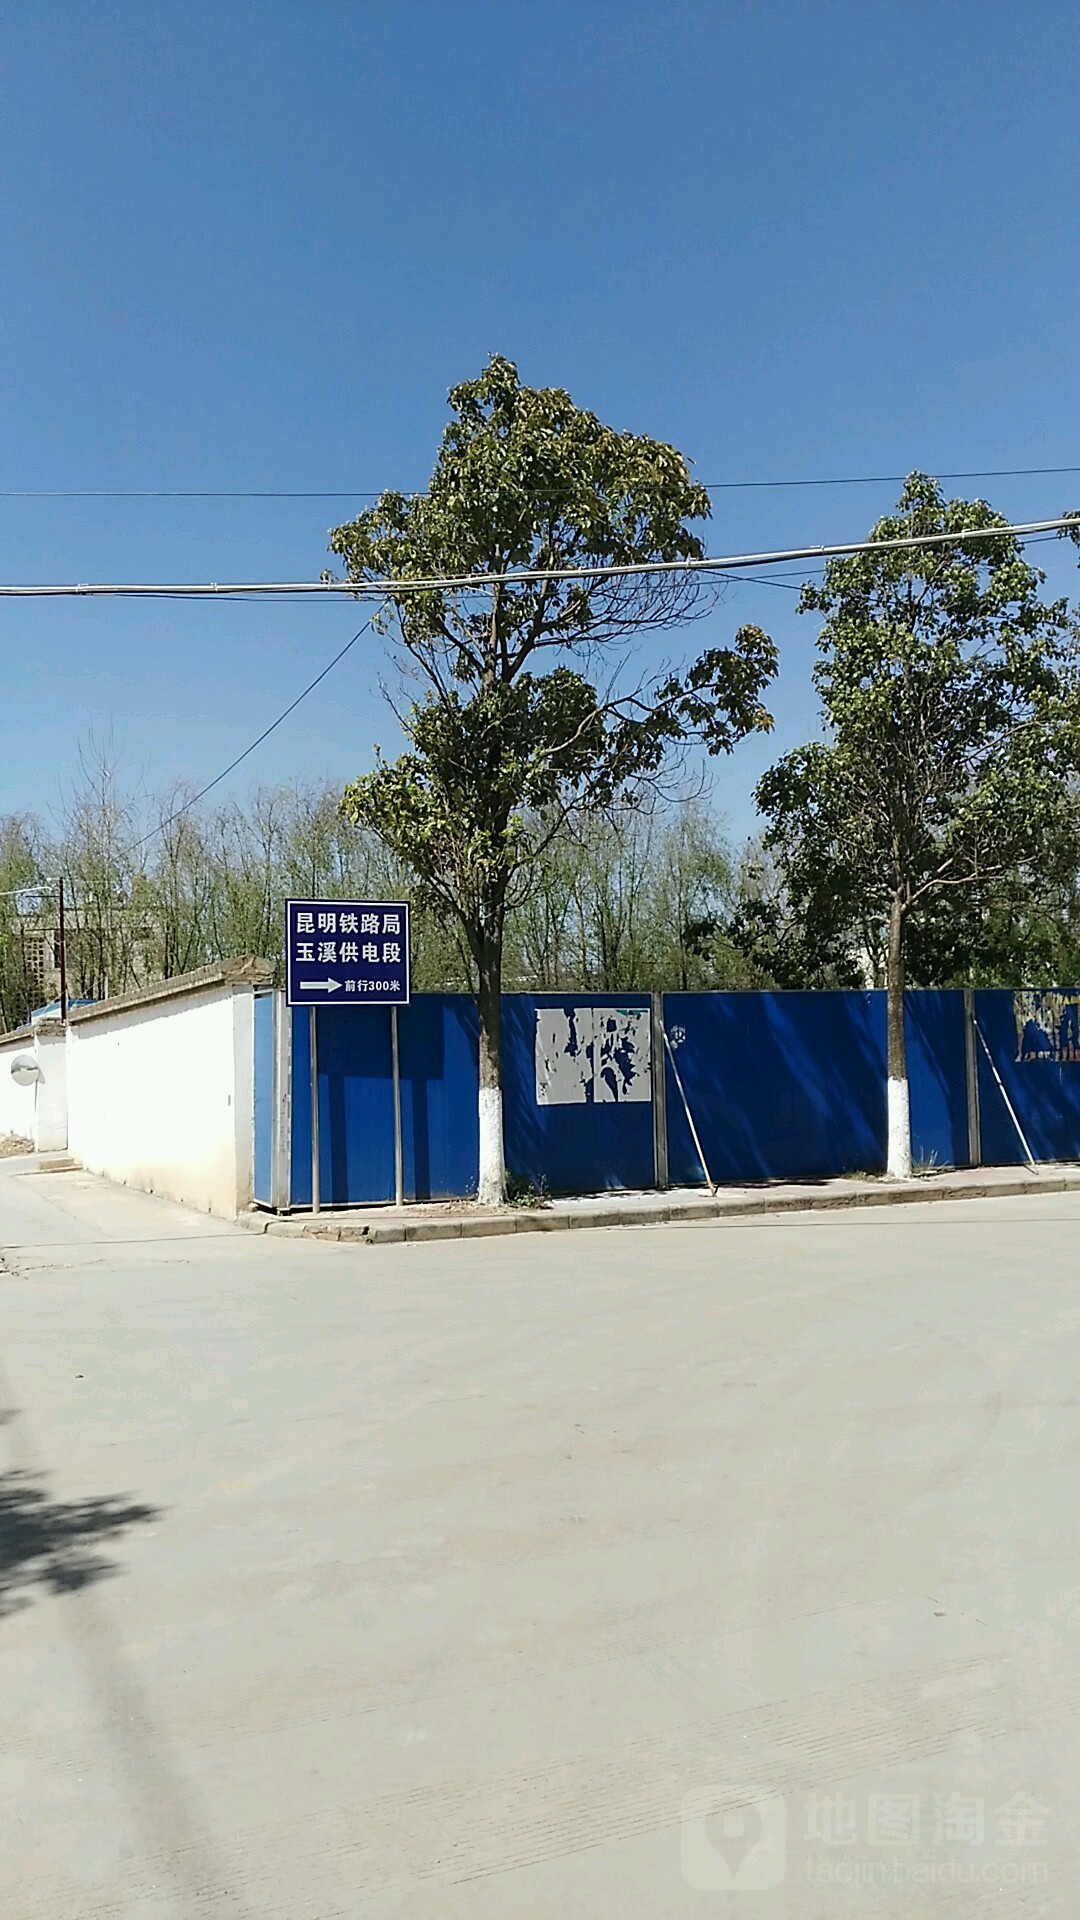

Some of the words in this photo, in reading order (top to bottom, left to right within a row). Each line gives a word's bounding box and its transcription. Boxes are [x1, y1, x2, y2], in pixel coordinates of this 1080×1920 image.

[296, 912, 401, 935] 昆明铁路局
[295, 941, 401, 963] 玉溪供电段
[344, 980, 401, 992] 前行300米
